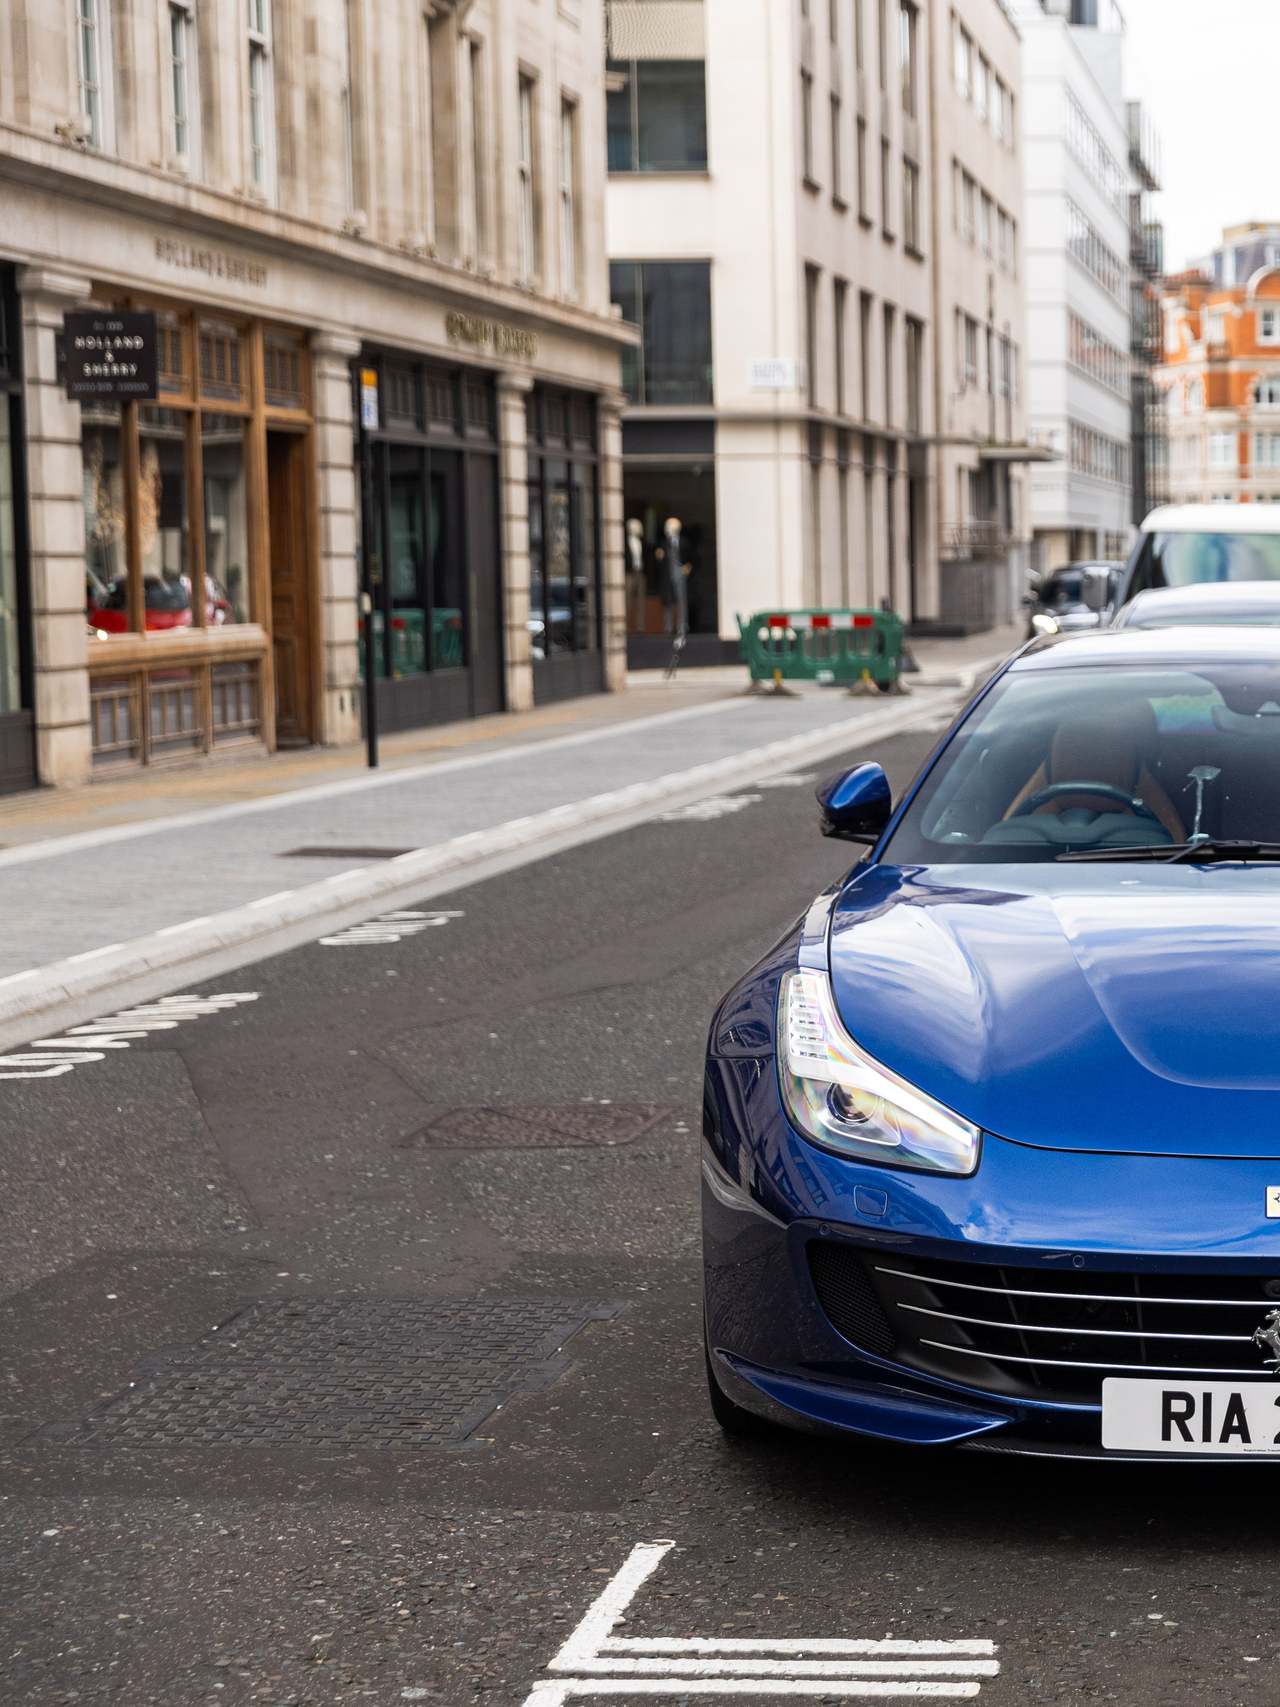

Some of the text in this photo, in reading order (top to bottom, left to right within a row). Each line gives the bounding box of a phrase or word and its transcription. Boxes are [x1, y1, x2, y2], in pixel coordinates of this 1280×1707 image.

[75, 335, 144, 350] HOLLAND
[105, 350, 114, 363] &
[83, 362, 137, 377] SHERRY
[1161, 1390, 1252, 1444] RIA
